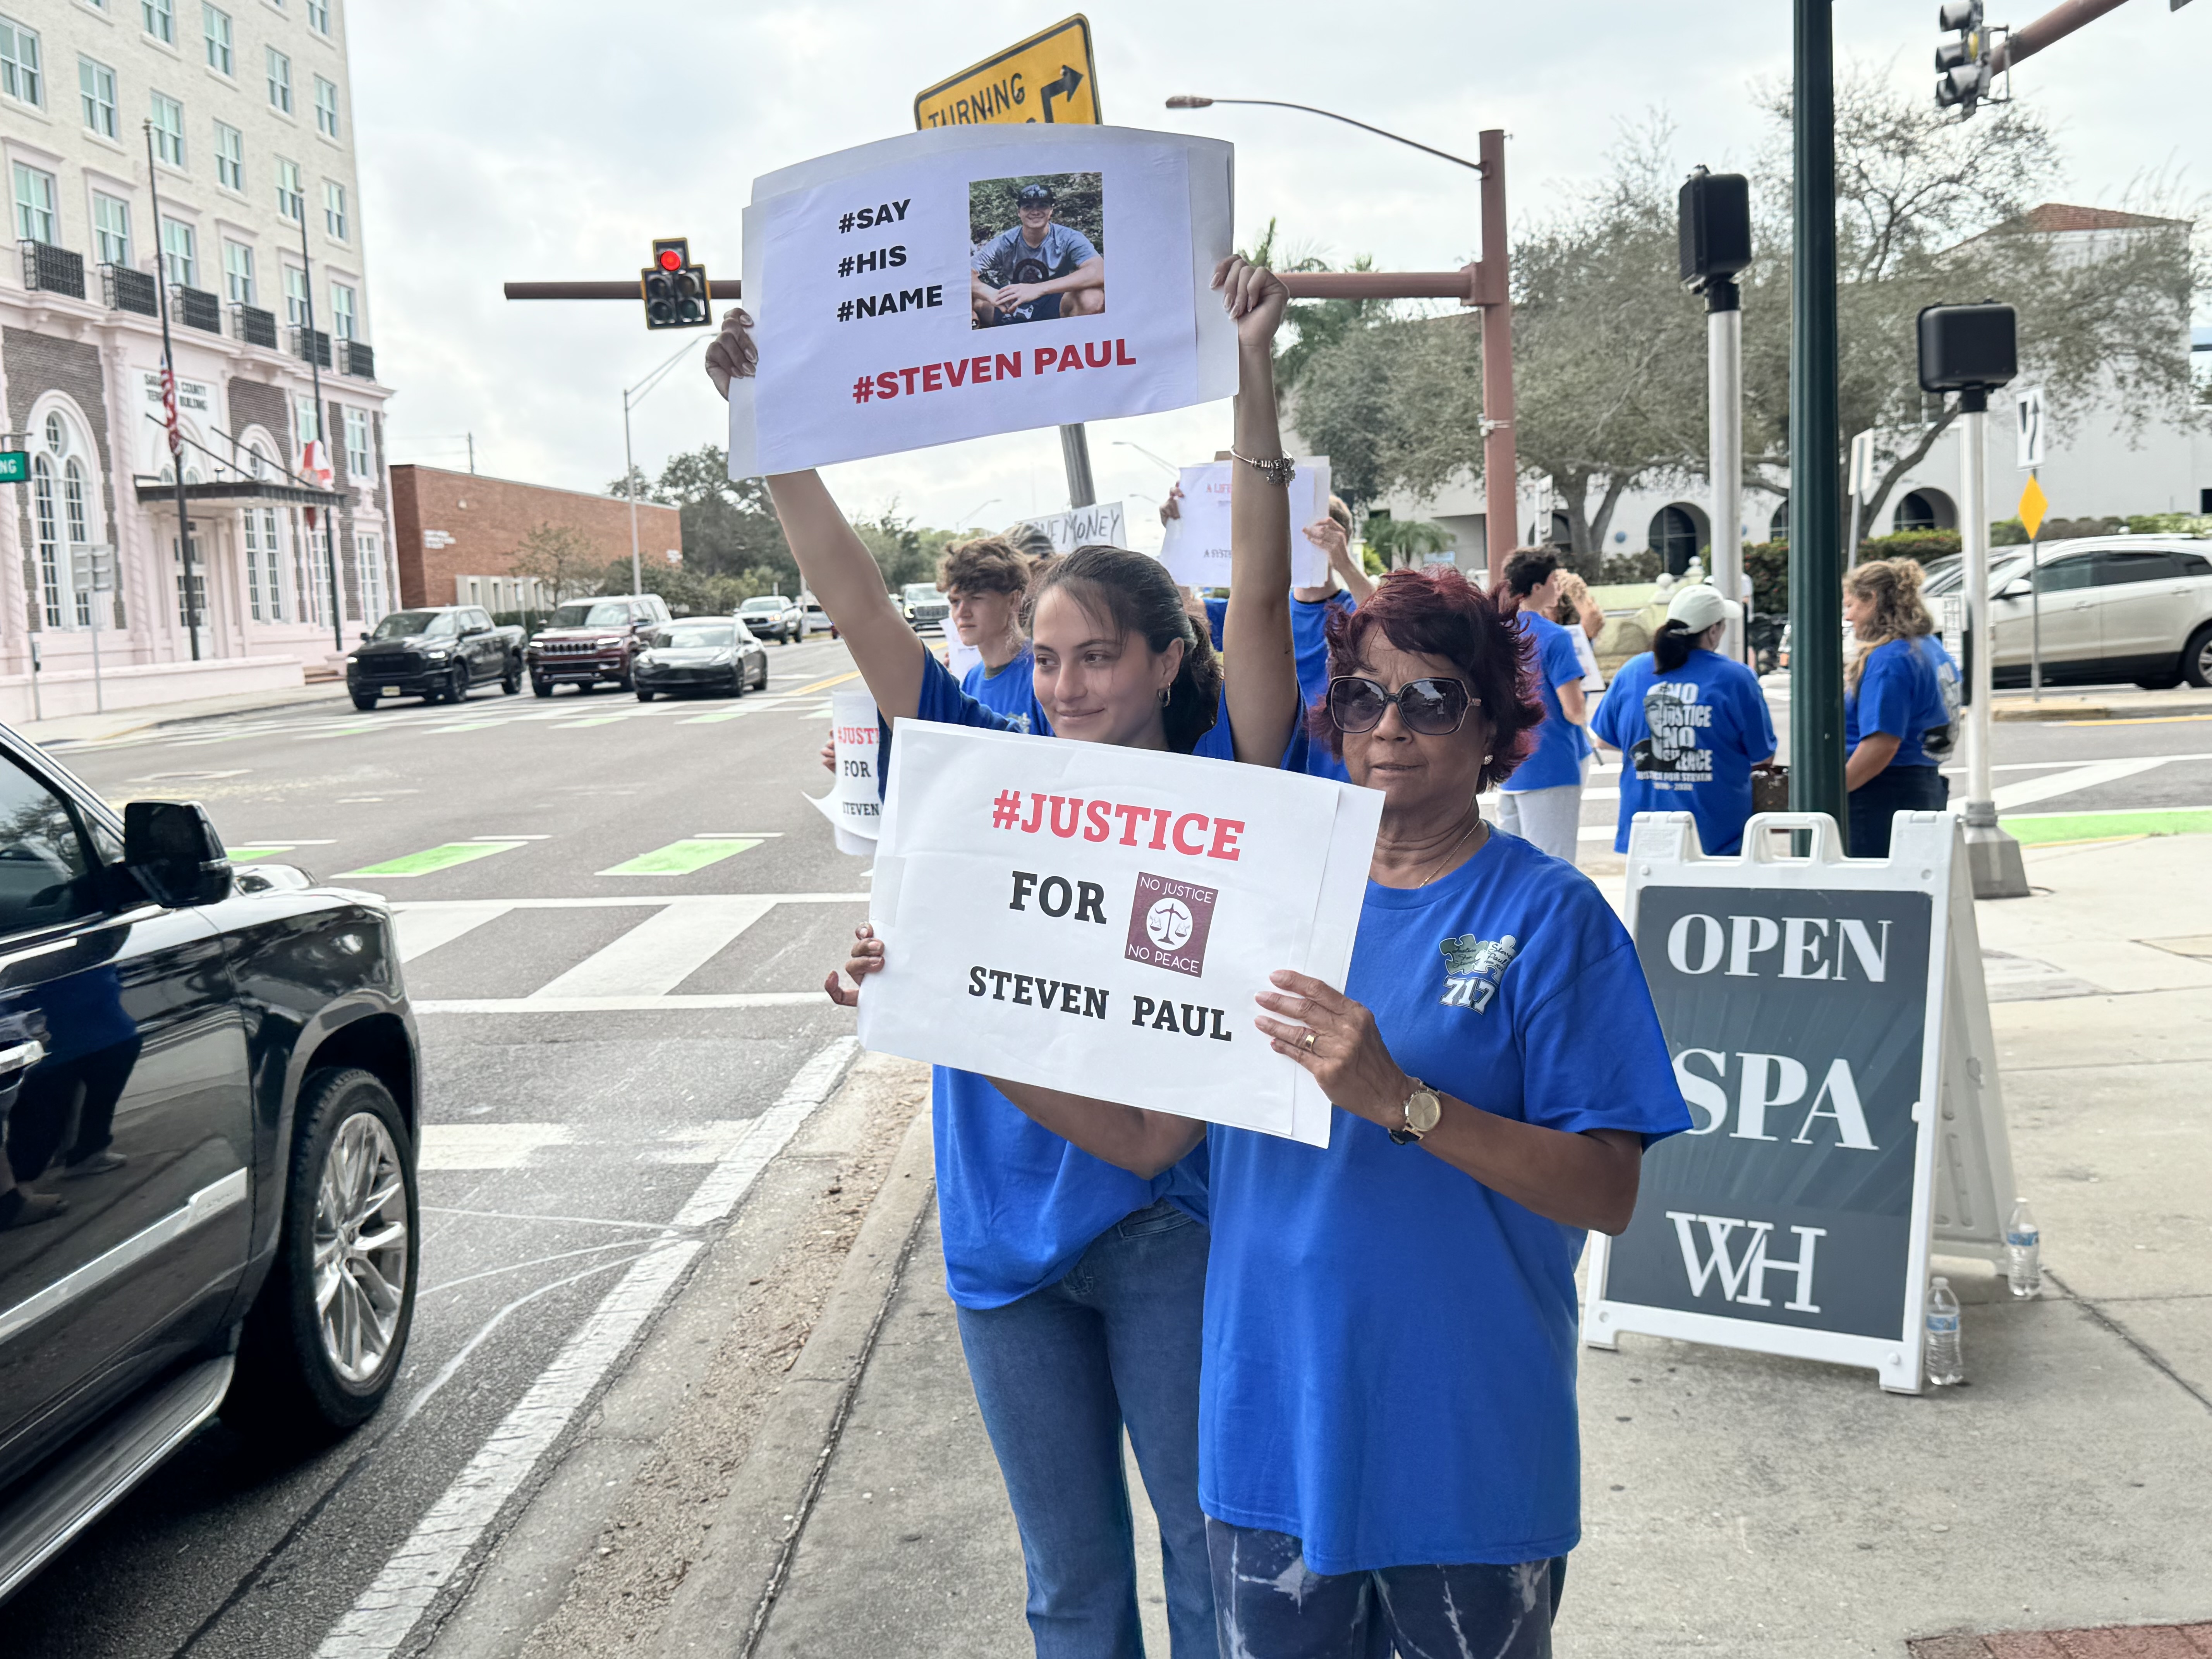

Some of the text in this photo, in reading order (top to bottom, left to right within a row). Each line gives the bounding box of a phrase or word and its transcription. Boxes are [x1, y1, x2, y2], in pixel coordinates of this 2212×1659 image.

[838, 198, 911, 234] #SAY
[838, 245, 907, 278] #HIS
[836, 284, 943, 322] #NAME
[852, 338, 1137, 404] #STEVEN PAUL
[1062, 509, 1120, 544] MONEY
[1662, 726, 1696, 748] NO
[844, 760, 871, 777] FOR
[992, 789, 1245, 861] #JUSTICE
[1009, 870, 1107, 925] FOR
[1140, 876, 1214, 903] NO JUSTICE
[1128, 943, 1199, 973] NO PEACE
[1667, 914, 1893, 982] OPEN
[968, 965, 1232, 1042] STEVEN PAUL
[1439, 975, 1496, 1015] 717
[1672, 1048, 1880, 1150] SPA
